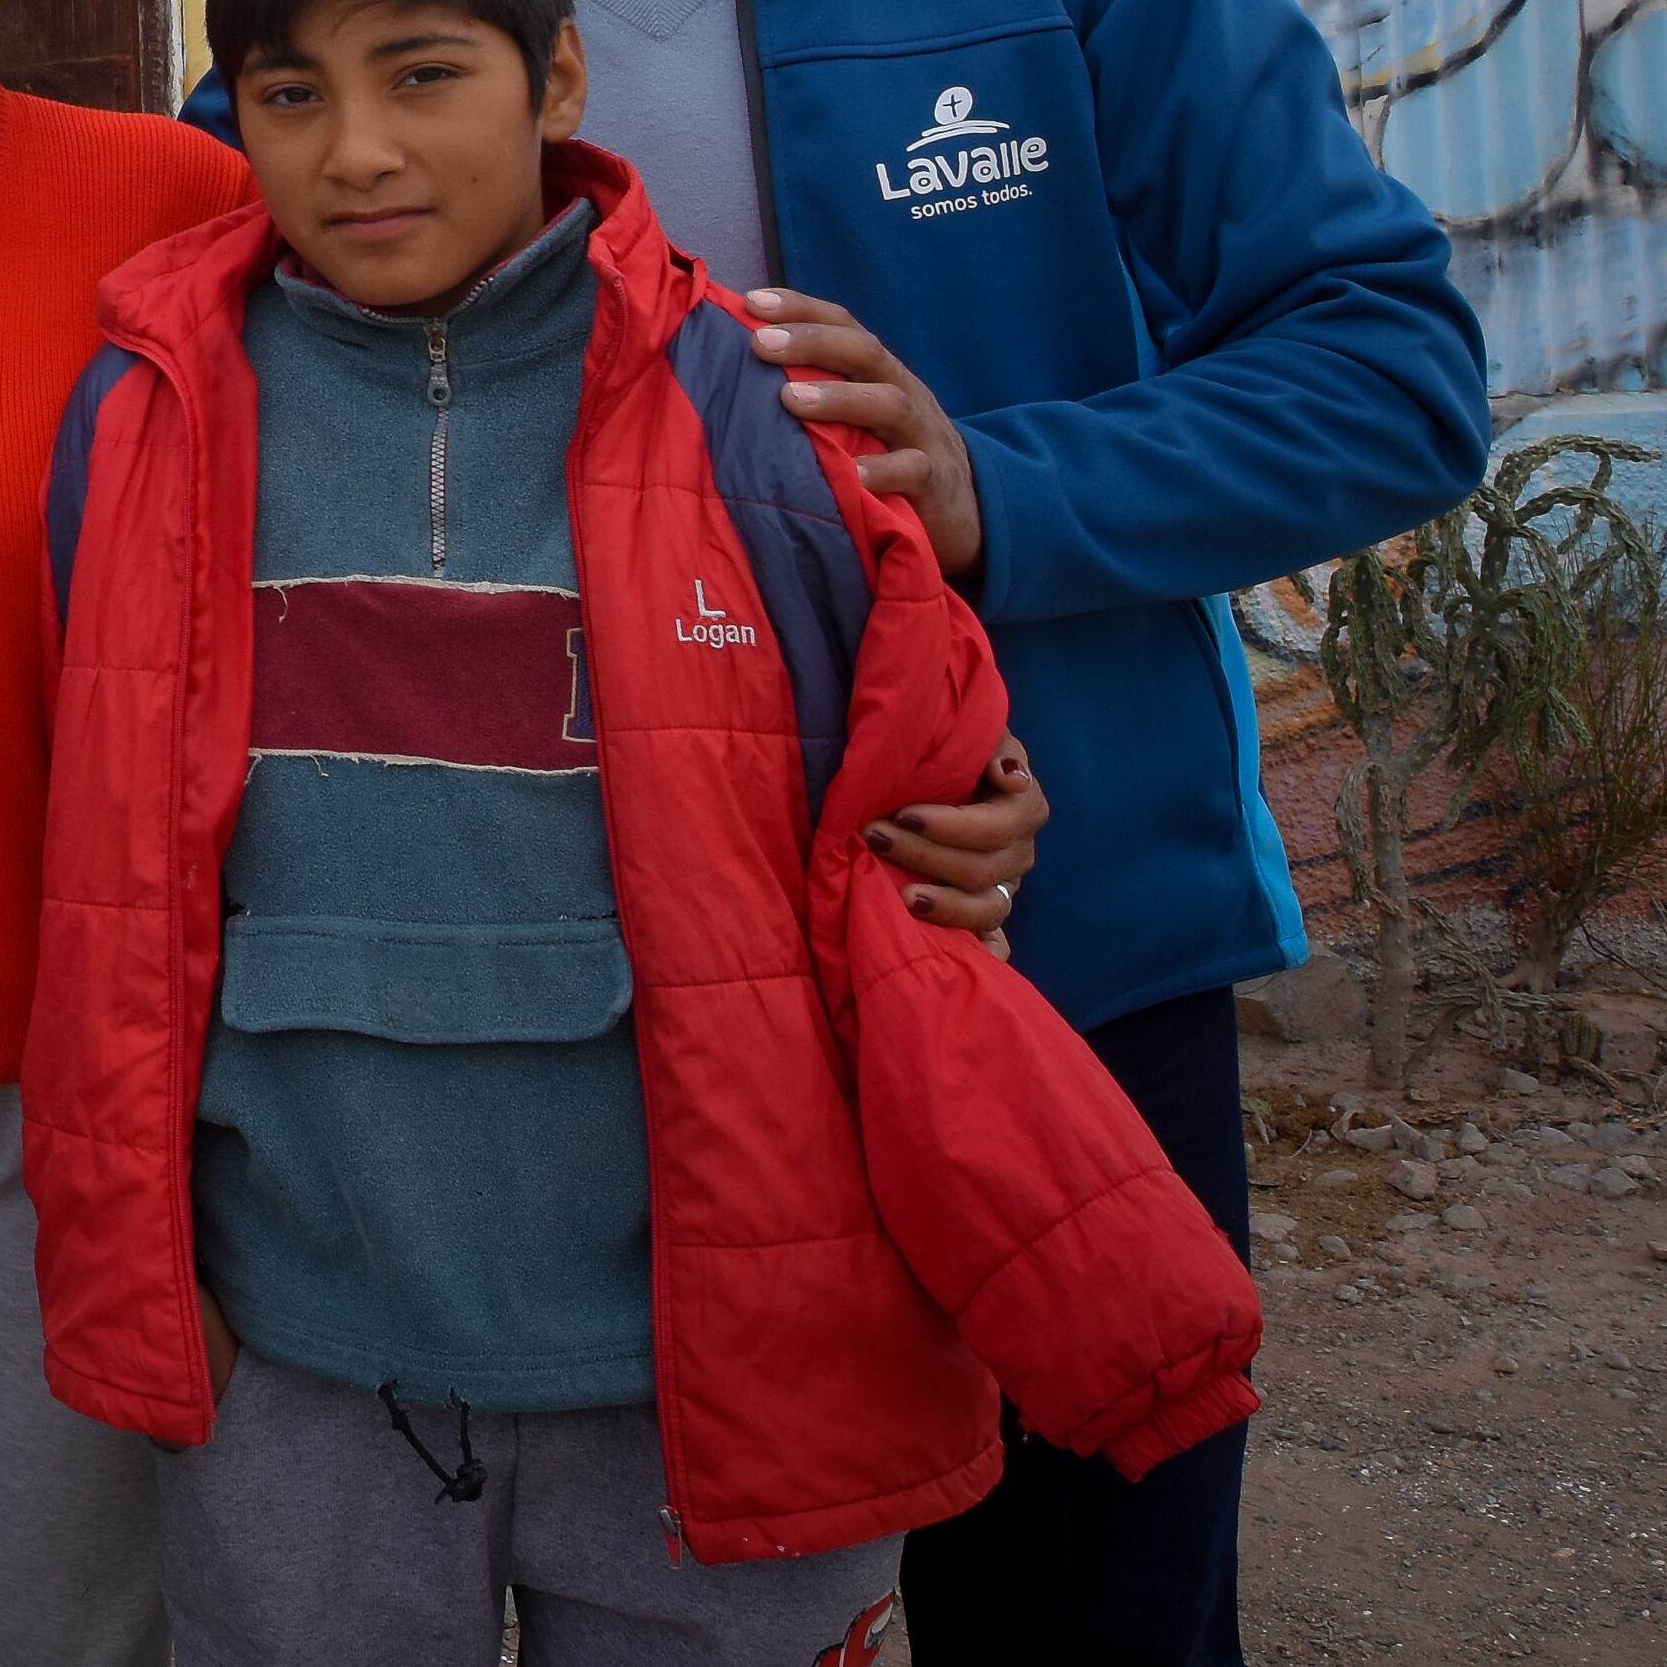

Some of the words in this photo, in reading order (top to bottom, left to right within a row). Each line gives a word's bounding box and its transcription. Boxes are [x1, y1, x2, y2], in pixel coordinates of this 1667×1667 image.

[875, 136, 1050, 201] Lavalle
[910, 193, 978, 220] somos
[981, 183, 1033, 206] todos.
[694, 579, 727, 619] L
[675, 618, 757, 649] Logan
